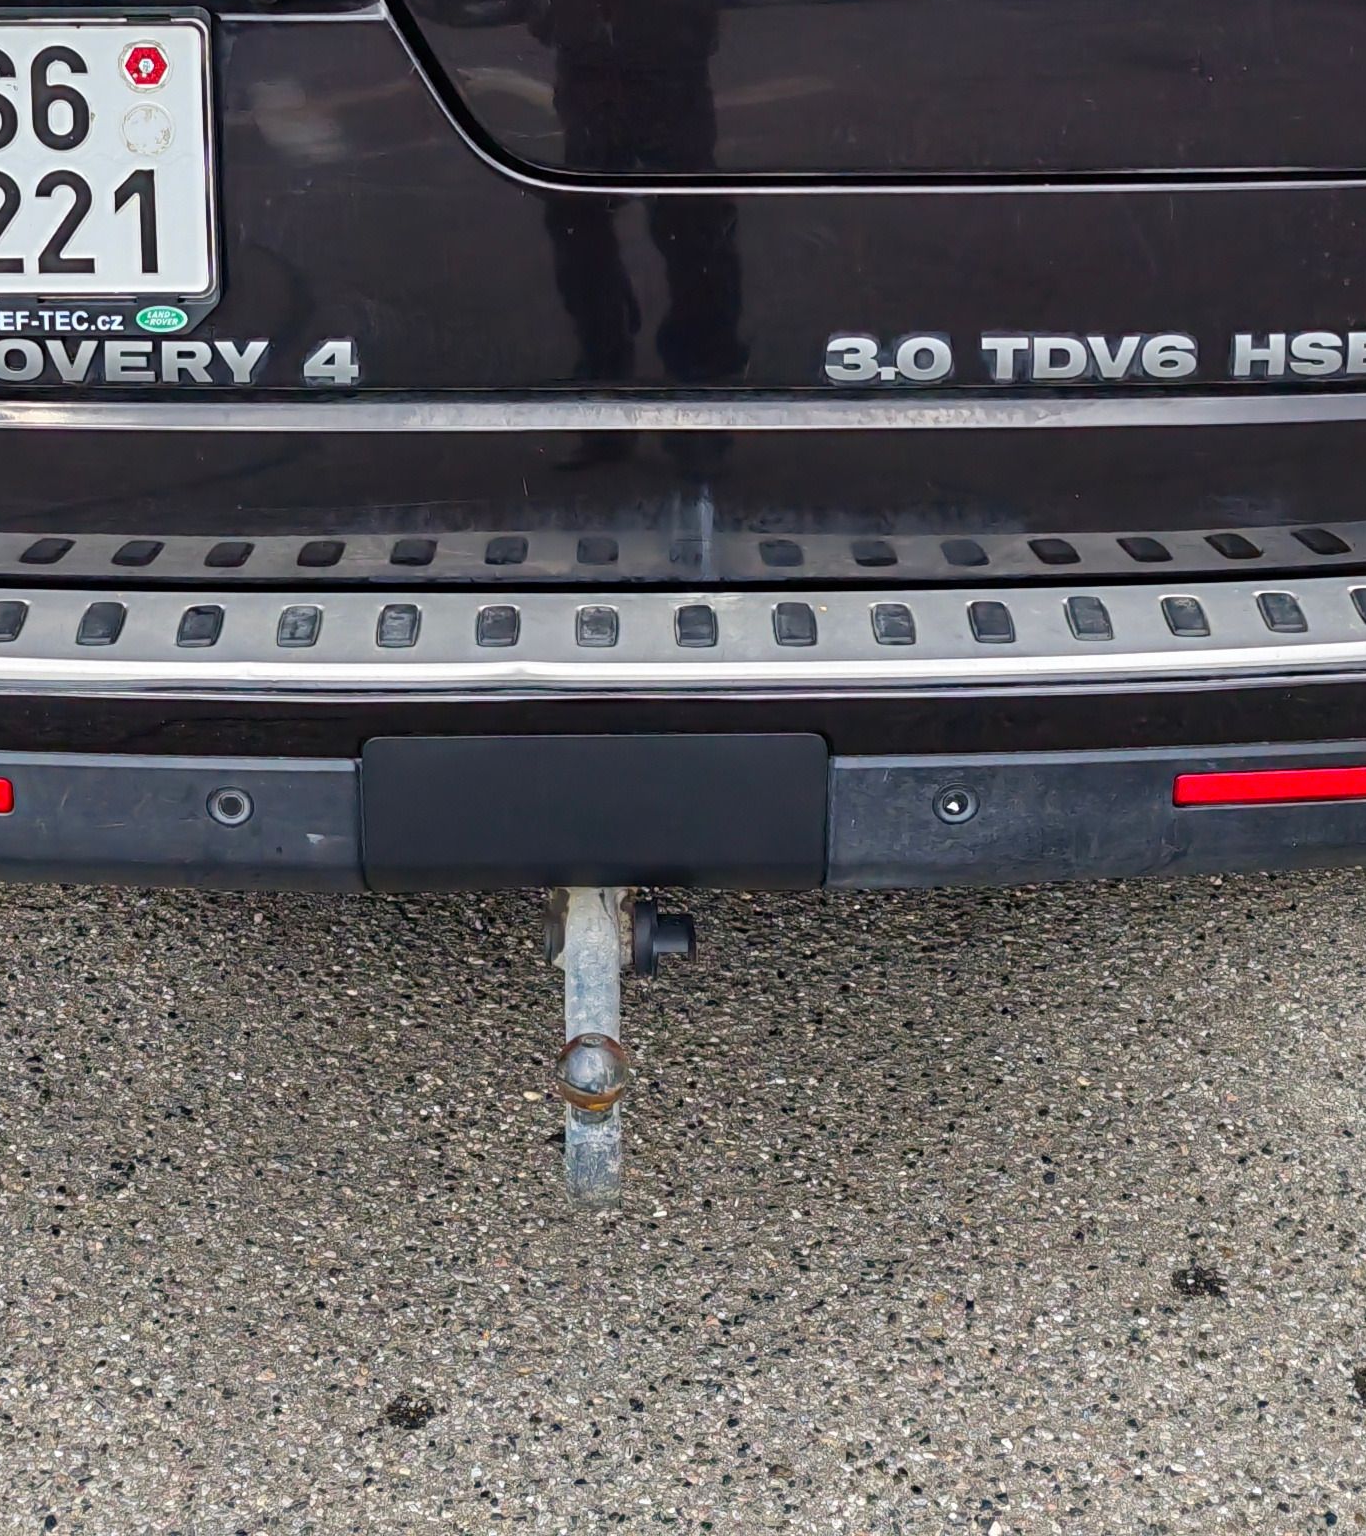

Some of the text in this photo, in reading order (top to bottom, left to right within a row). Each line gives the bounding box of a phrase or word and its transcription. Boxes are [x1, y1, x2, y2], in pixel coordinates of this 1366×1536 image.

[147, 310, 171, 319] LAND
[149, 318, 179, 327] ROVER
[303, 340, 359, 385] 4
[825, 336, 952, 382] 3.0
[980, 334, 1197, 380] TDV6
